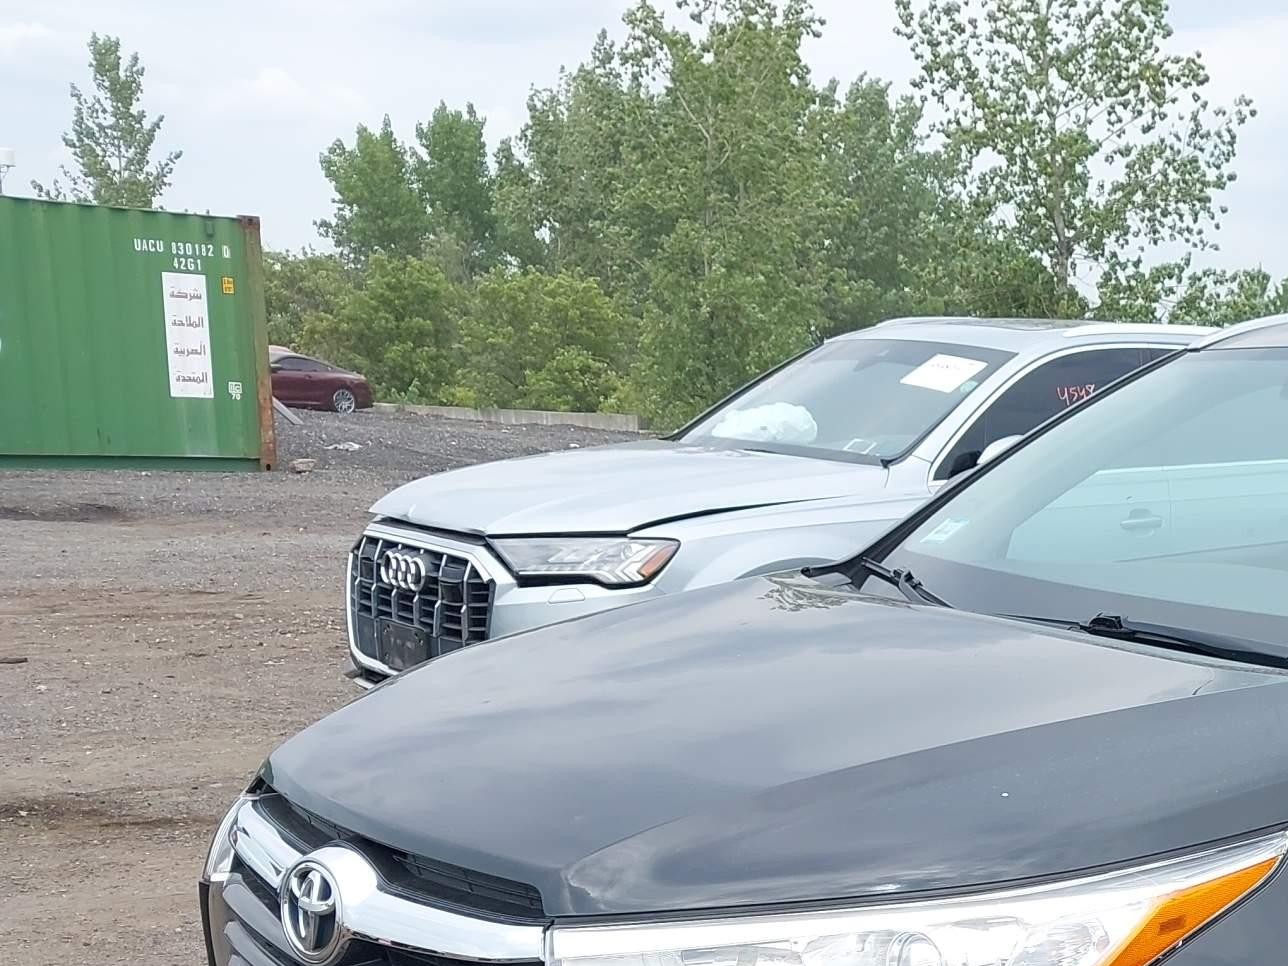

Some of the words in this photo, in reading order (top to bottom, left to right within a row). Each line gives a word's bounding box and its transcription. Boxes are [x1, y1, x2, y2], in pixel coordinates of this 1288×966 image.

[133, 238, 165, 253] UACU
[170, 241, 215, 257] 830182
[173, 257, 202, 271] 42G1
